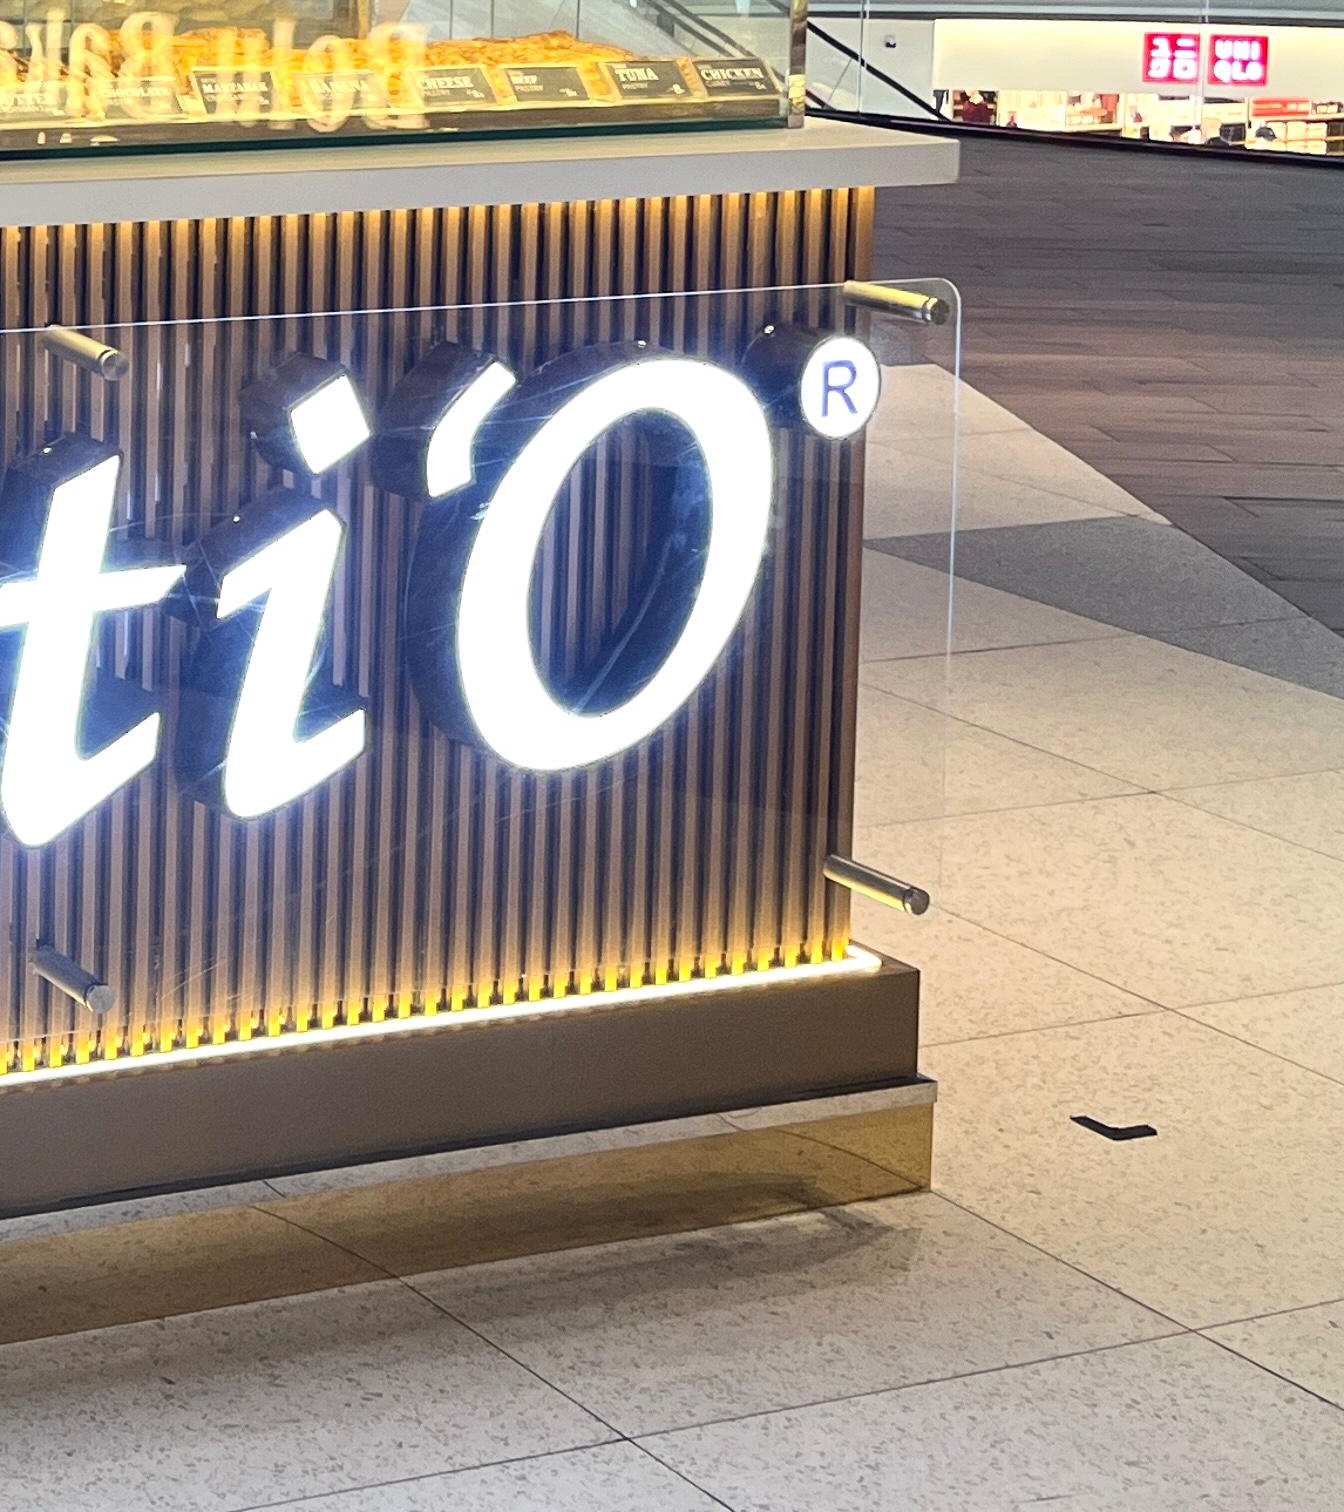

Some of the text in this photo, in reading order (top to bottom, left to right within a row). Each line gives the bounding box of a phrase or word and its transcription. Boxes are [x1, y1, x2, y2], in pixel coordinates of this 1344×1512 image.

[1214, 39, 1261, 61] UNI
[614, 67, 659, 82] TUNA
[700, 67, 764, 80] CHICKEN
